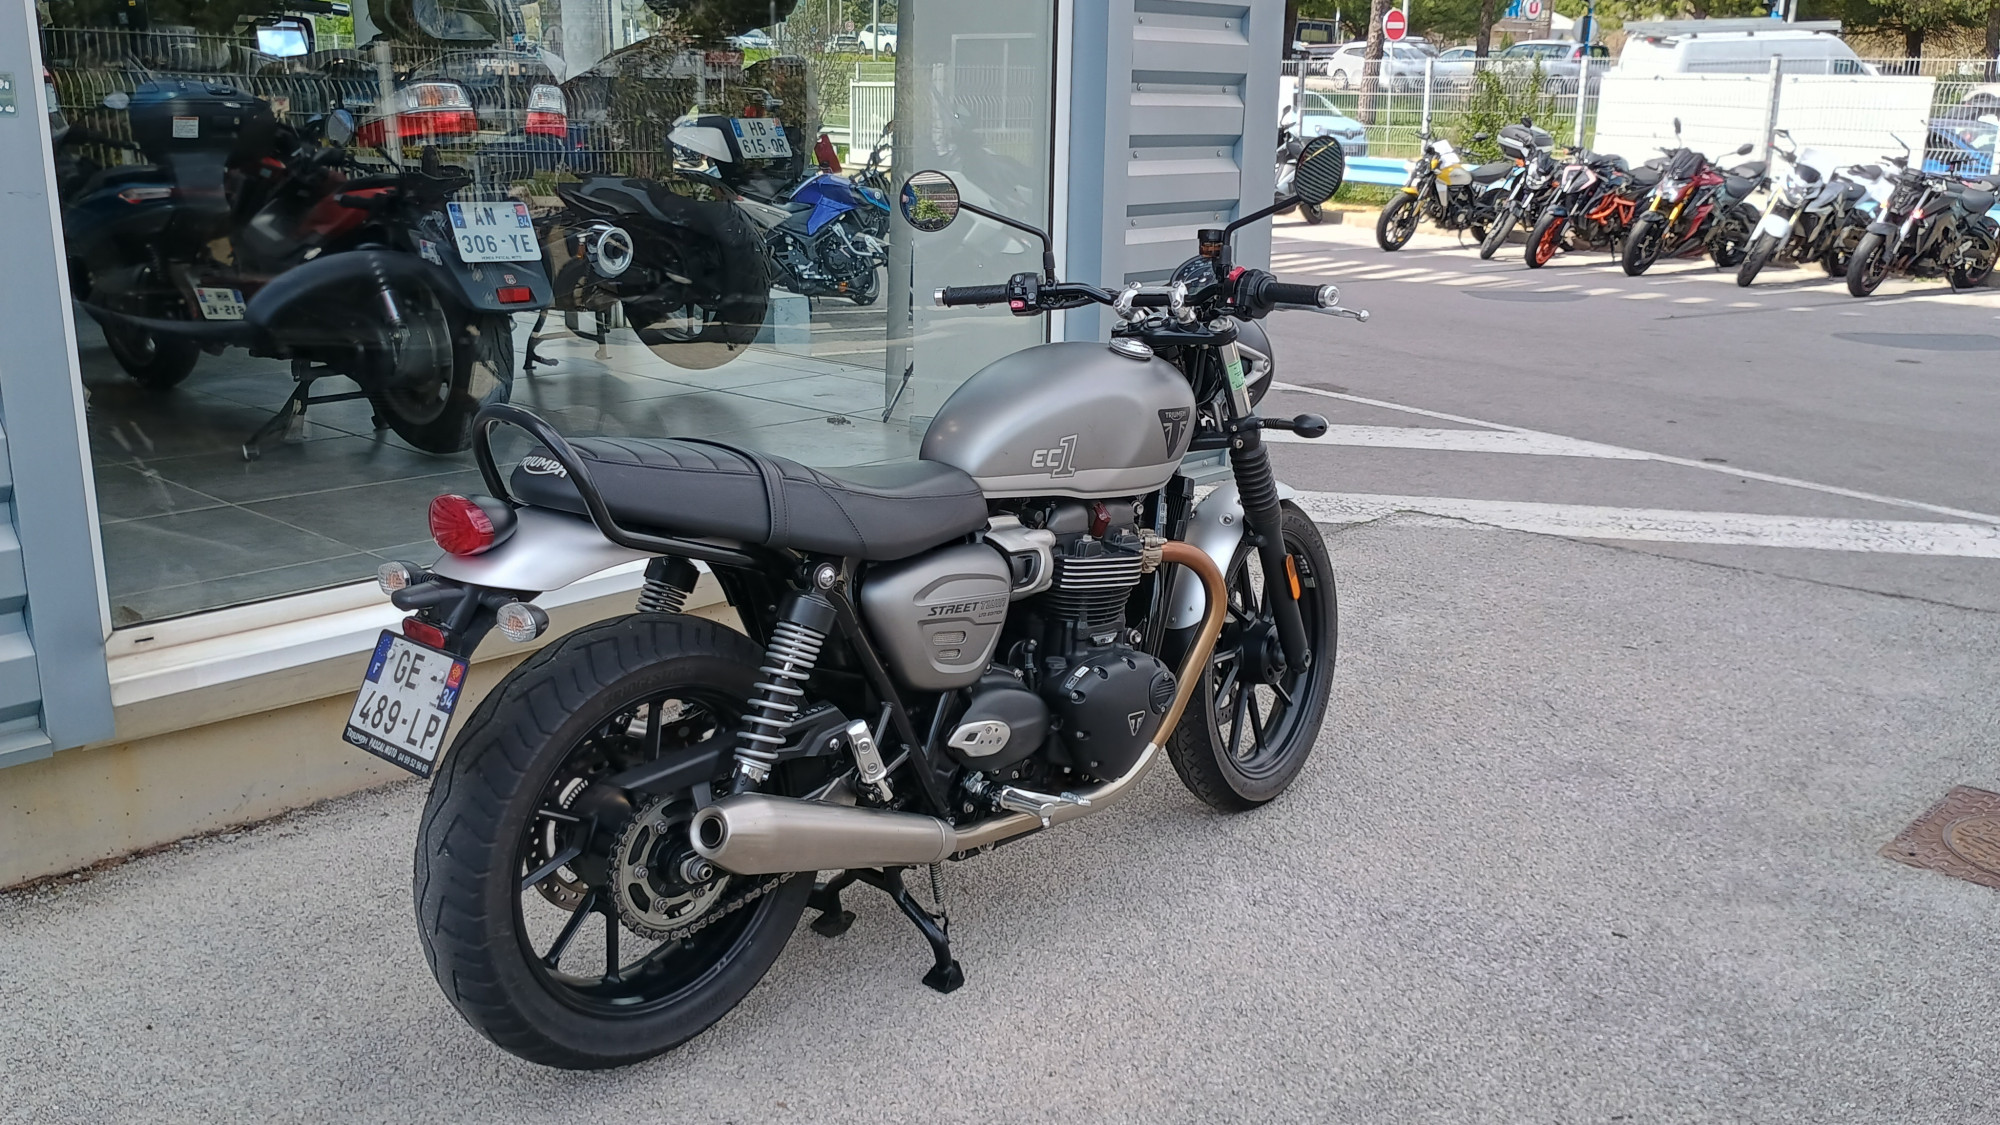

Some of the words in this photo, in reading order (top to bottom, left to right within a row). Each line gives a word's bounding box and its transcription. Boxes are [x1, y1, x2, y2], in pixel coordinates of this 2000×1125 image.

[748, 121, 767, 136] HB
[474, 207, 497, 226] AN
[518, 216, 531, 227] 34
[461, 234, 534, 254] 306-YE
[1165, 410, 1187, 421] TRIUMPH
[1031, 433, 1078, 478] EC1
[519, 456, 568, 478] TRIUMPH
[927, 601, 980, 616] STREET
[373, 662, 381, 674] F
[393, 650, 425, 690] GE
[439, 688, 455, 709] 34
[358, 690, 442, 750] 489-LP
[369, 738, 385, 753] PASCAL
[385, 745, 398, 758] MOTO
[398, 753, 405, 762] 04
[410, 758, 417, 768] 52
